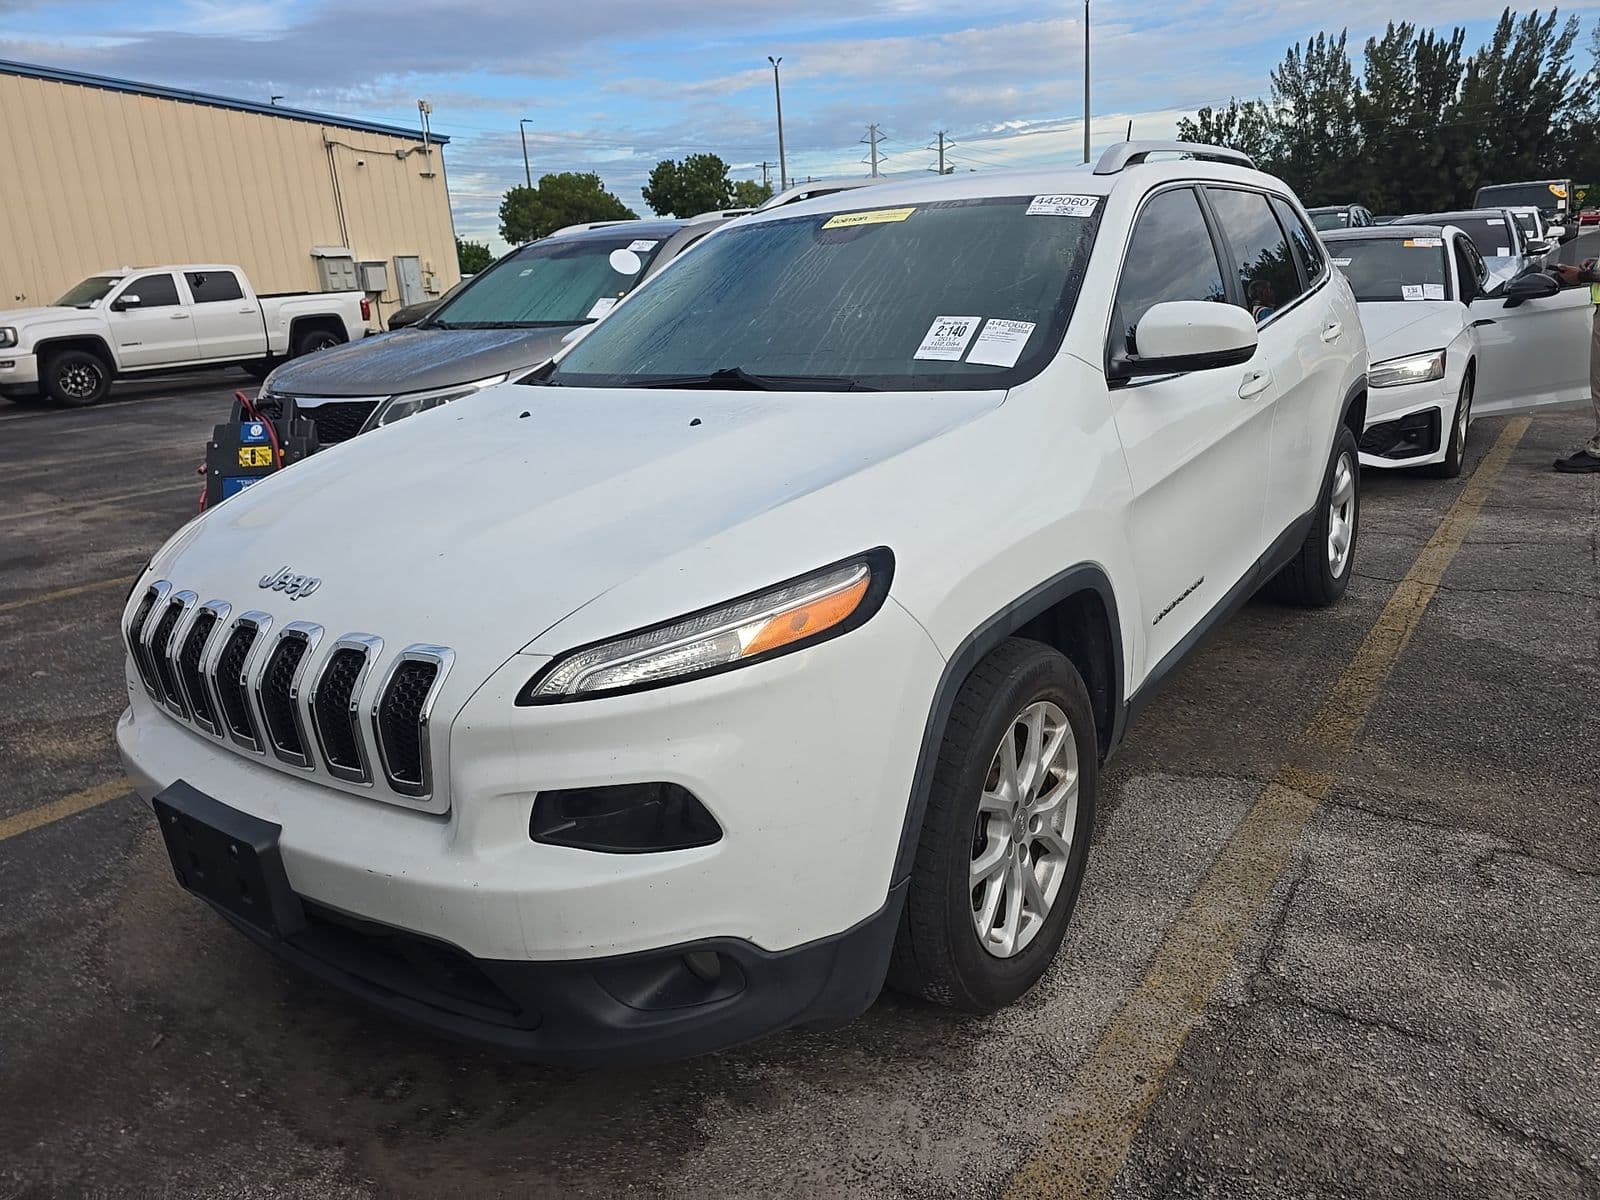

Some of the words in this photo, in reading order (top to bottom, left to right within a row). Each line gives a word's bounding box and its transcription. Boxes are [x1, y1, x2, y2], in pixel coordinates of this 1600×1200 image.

[1035, 197, 1099, 206] 4420607
[989, 321, 1034, 329] 4420607
[935, 325, 968, 337] 2:140
[258, 565, 322, 601] Jeep
